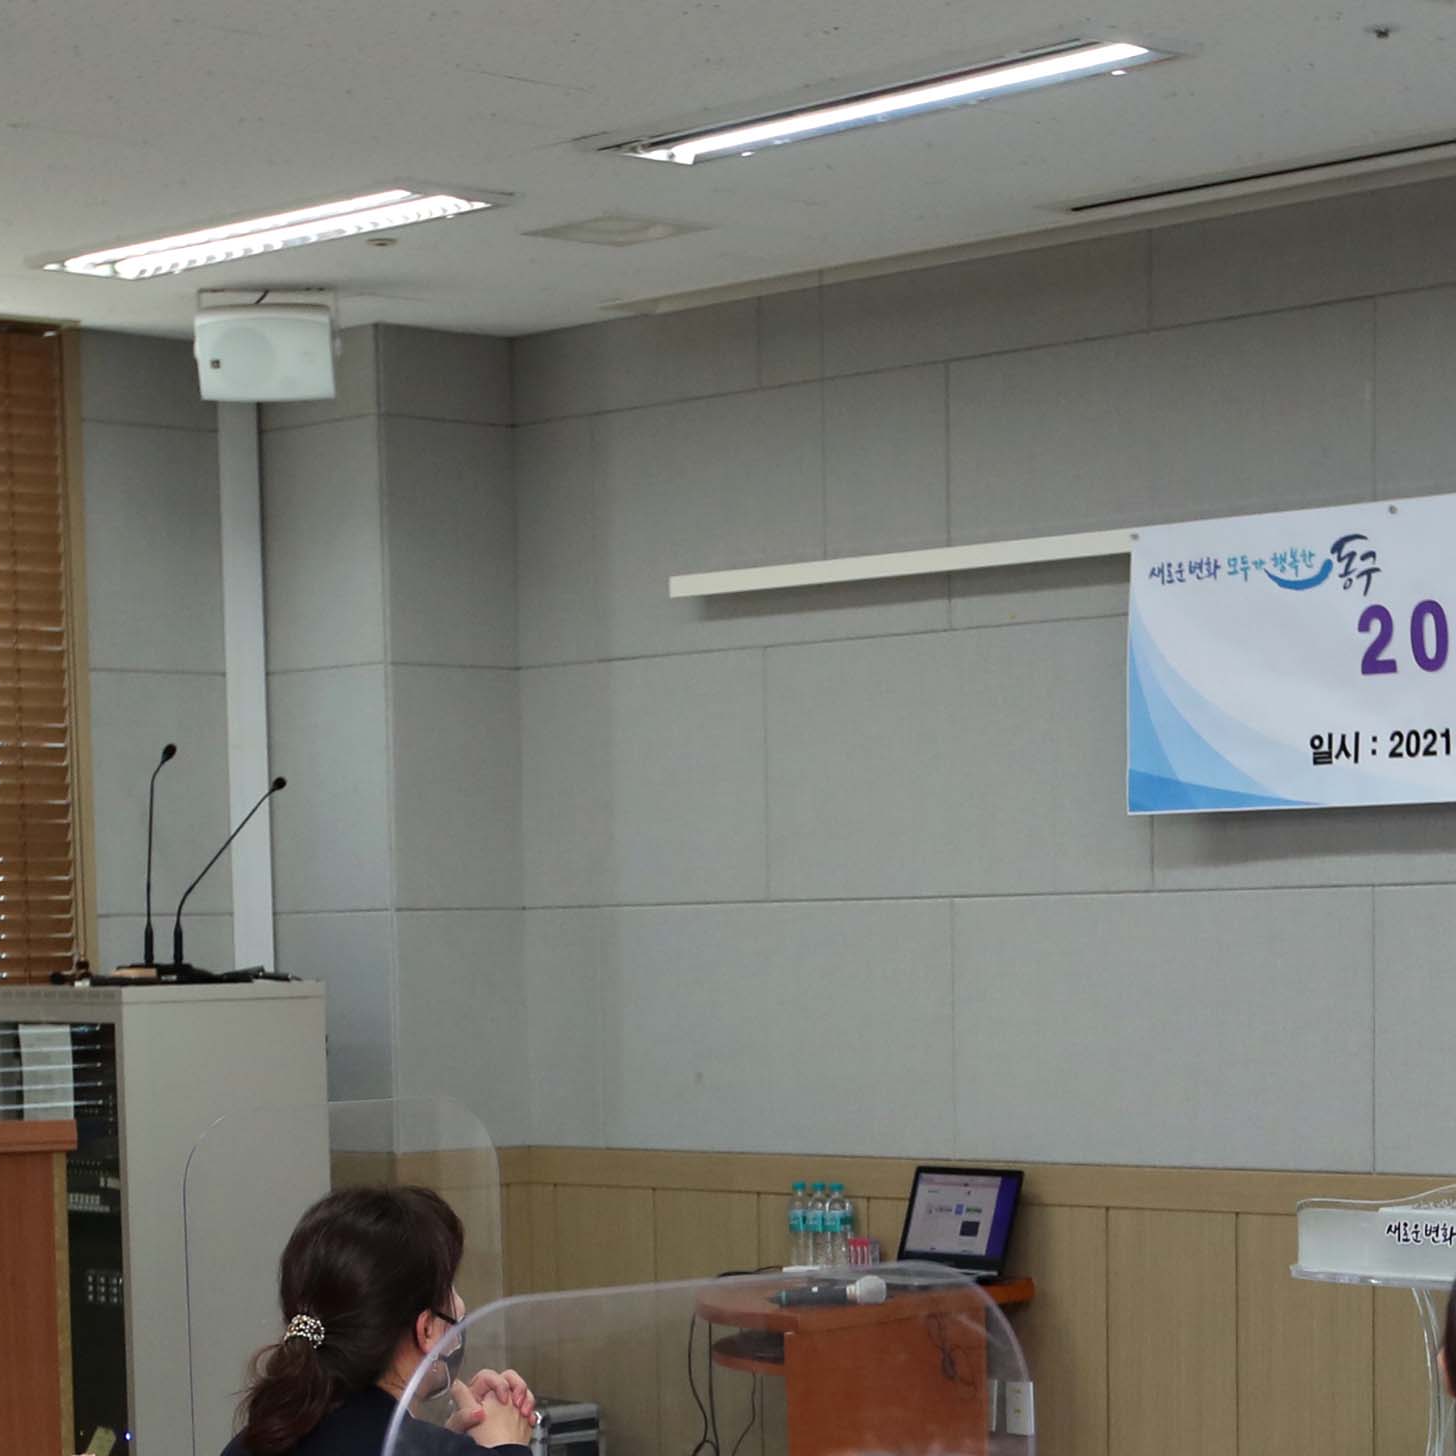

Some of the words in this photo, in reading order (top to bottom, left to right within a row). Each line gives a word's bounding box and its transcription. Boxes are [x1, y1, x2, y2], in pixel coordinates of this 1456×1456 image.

[1148, 557, 1186, 586] 새로운
[1187, 556, 1222, 581] 변화
[1308, 729, 1362, 768] 일시
